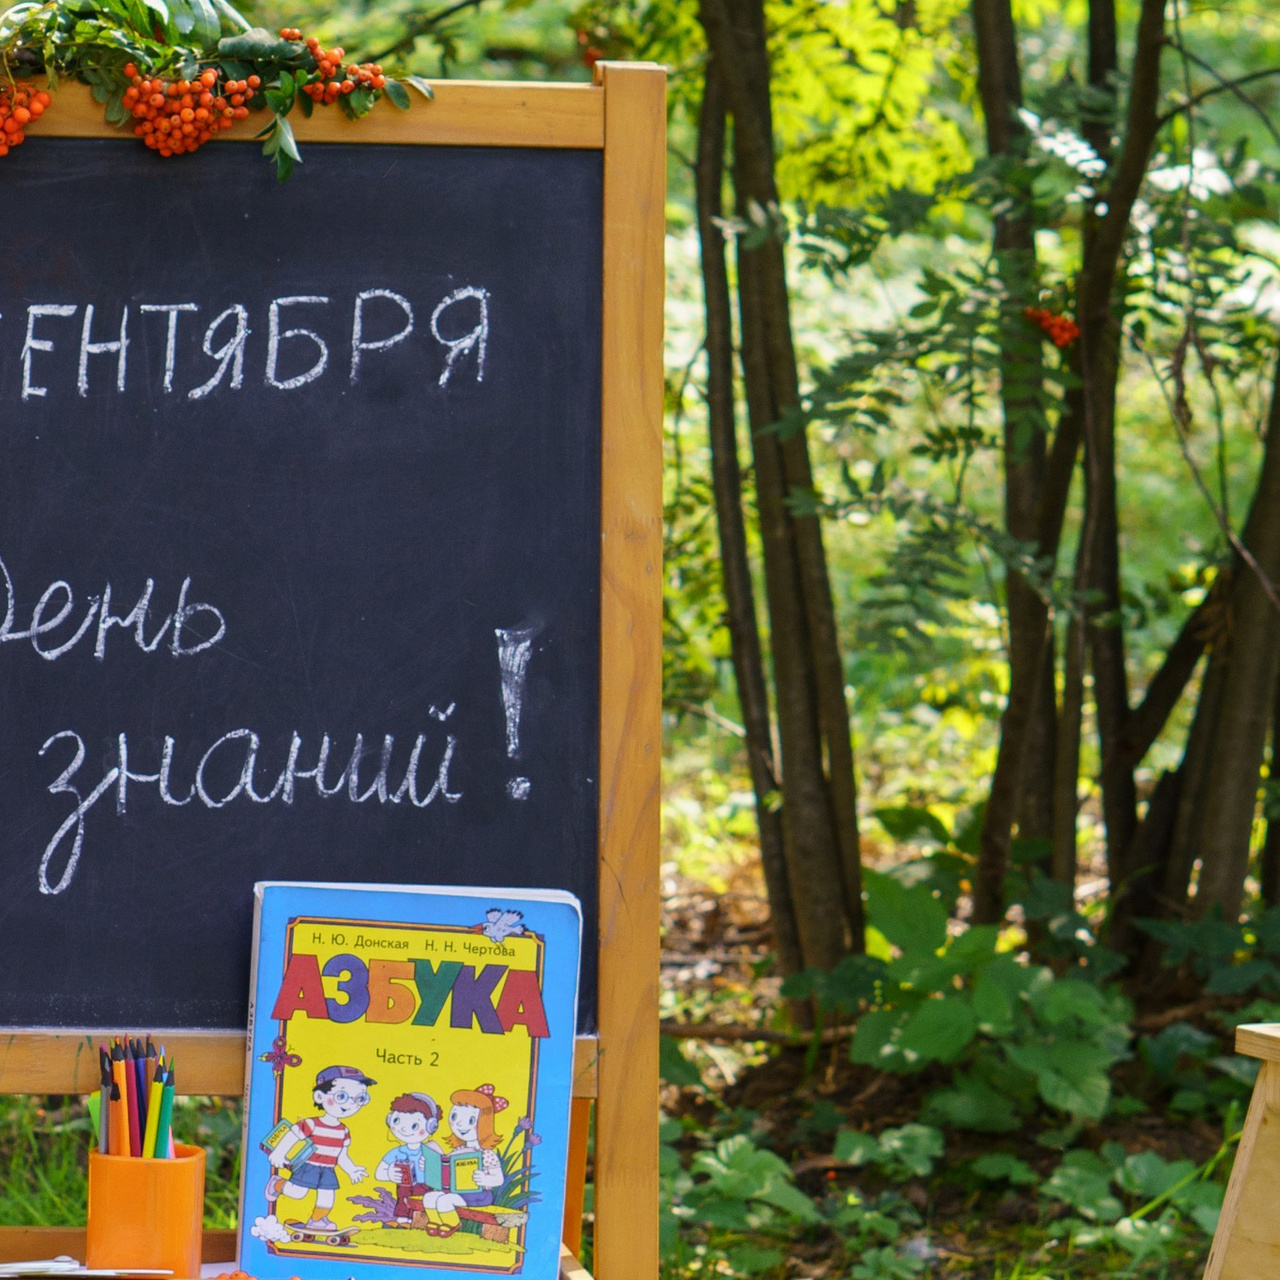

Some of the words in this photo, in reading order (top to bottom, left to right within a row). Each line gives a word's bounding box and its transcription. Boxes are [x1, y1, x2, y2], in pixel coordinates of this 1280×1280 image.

[311, 932, 325, 945] Н.
[331, 933, 349, 946] Ю.
[353, 934, 410, 950] Донская
[424, 939, 438, 952] Н.
[443, 941, 457, 953] Н.
[462, 942, 516, 958] Чертова
[270, 953, 551, 1039] АЗБУКА
[375, 1048, 423, 1066] Часть
[429, 1051, 440, 1067] 2
